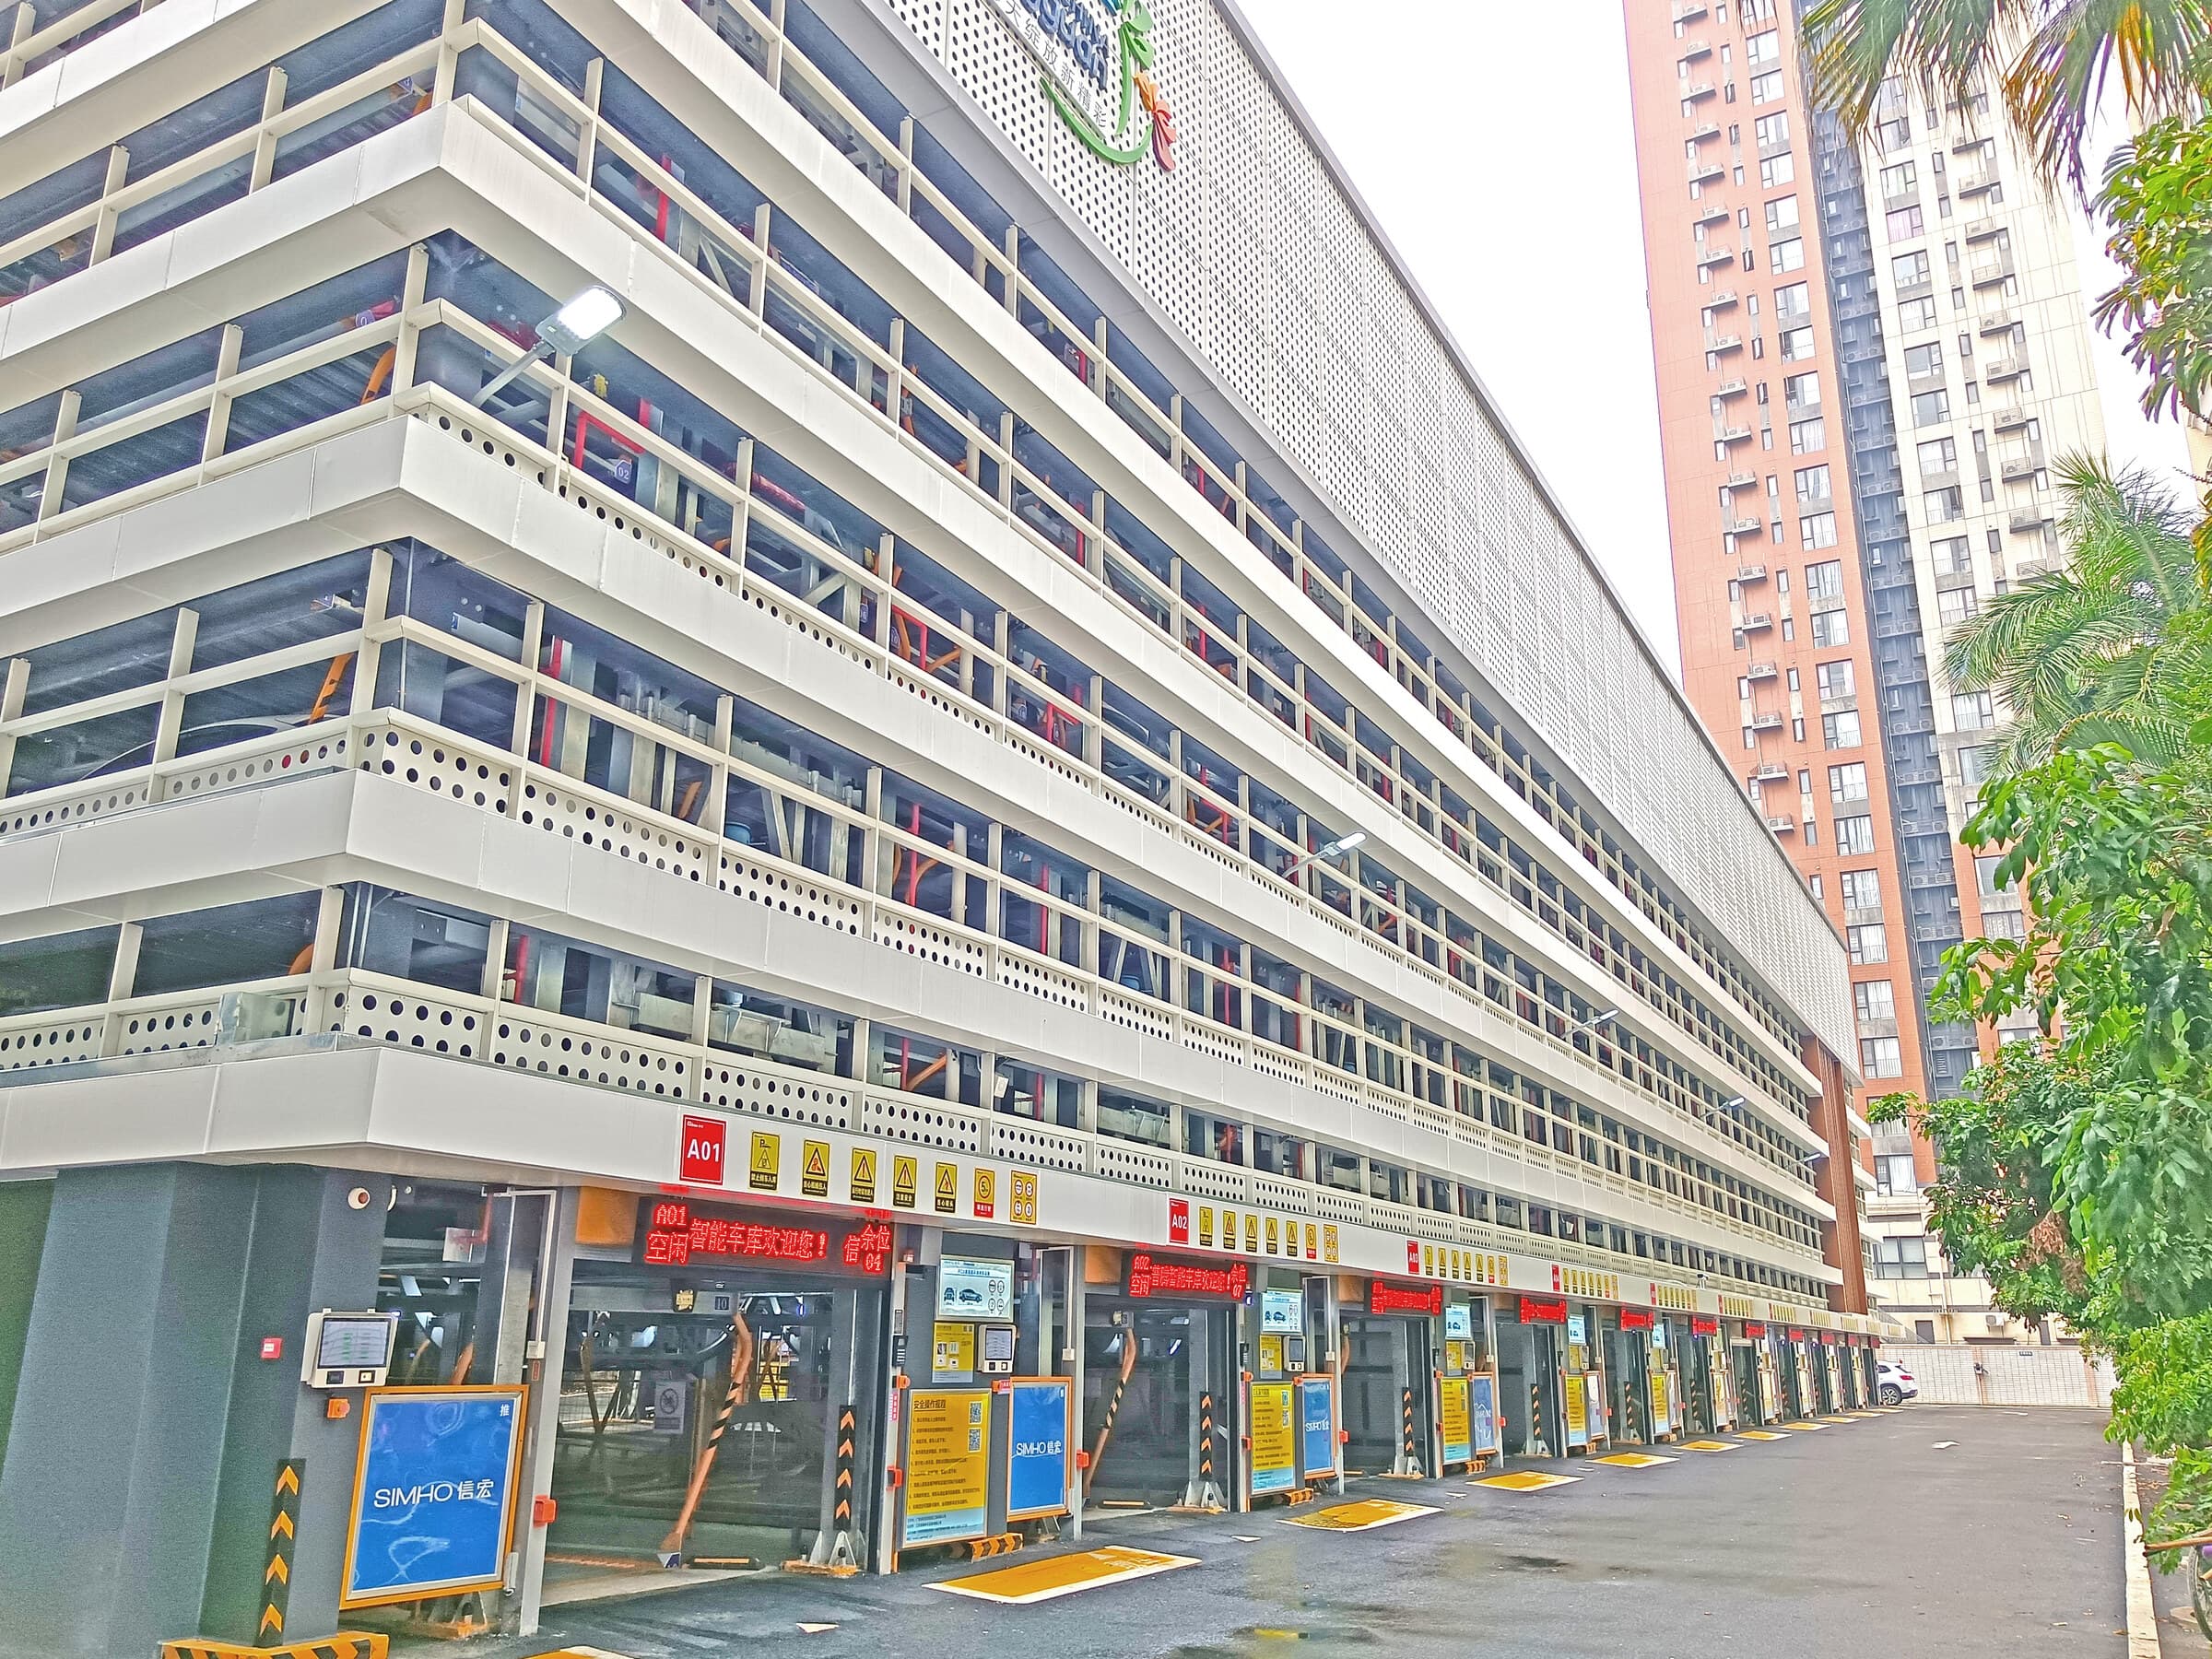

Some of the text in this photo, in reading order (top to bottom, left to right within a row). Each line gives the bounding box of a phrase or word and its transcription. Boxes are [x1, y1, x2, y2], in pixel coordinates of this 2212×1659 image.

[618, 467, 629, 480] 02
[687, 1138, 720, 1162] A01
[656, 1205, 686, 1226] A01
[1171, 1214, 1187, 1230] A02
[646, 1230, 688, 1264] 空闲
[844, 1234, 860, 1263] 信
[861, 1224, 890, 1252] 余位
[500, 1404, 511, 1417] 推
[1016, 1441, 1046, 1455] SIMHO
[373, 1478, 494, 1508] SIMHO 信宏
